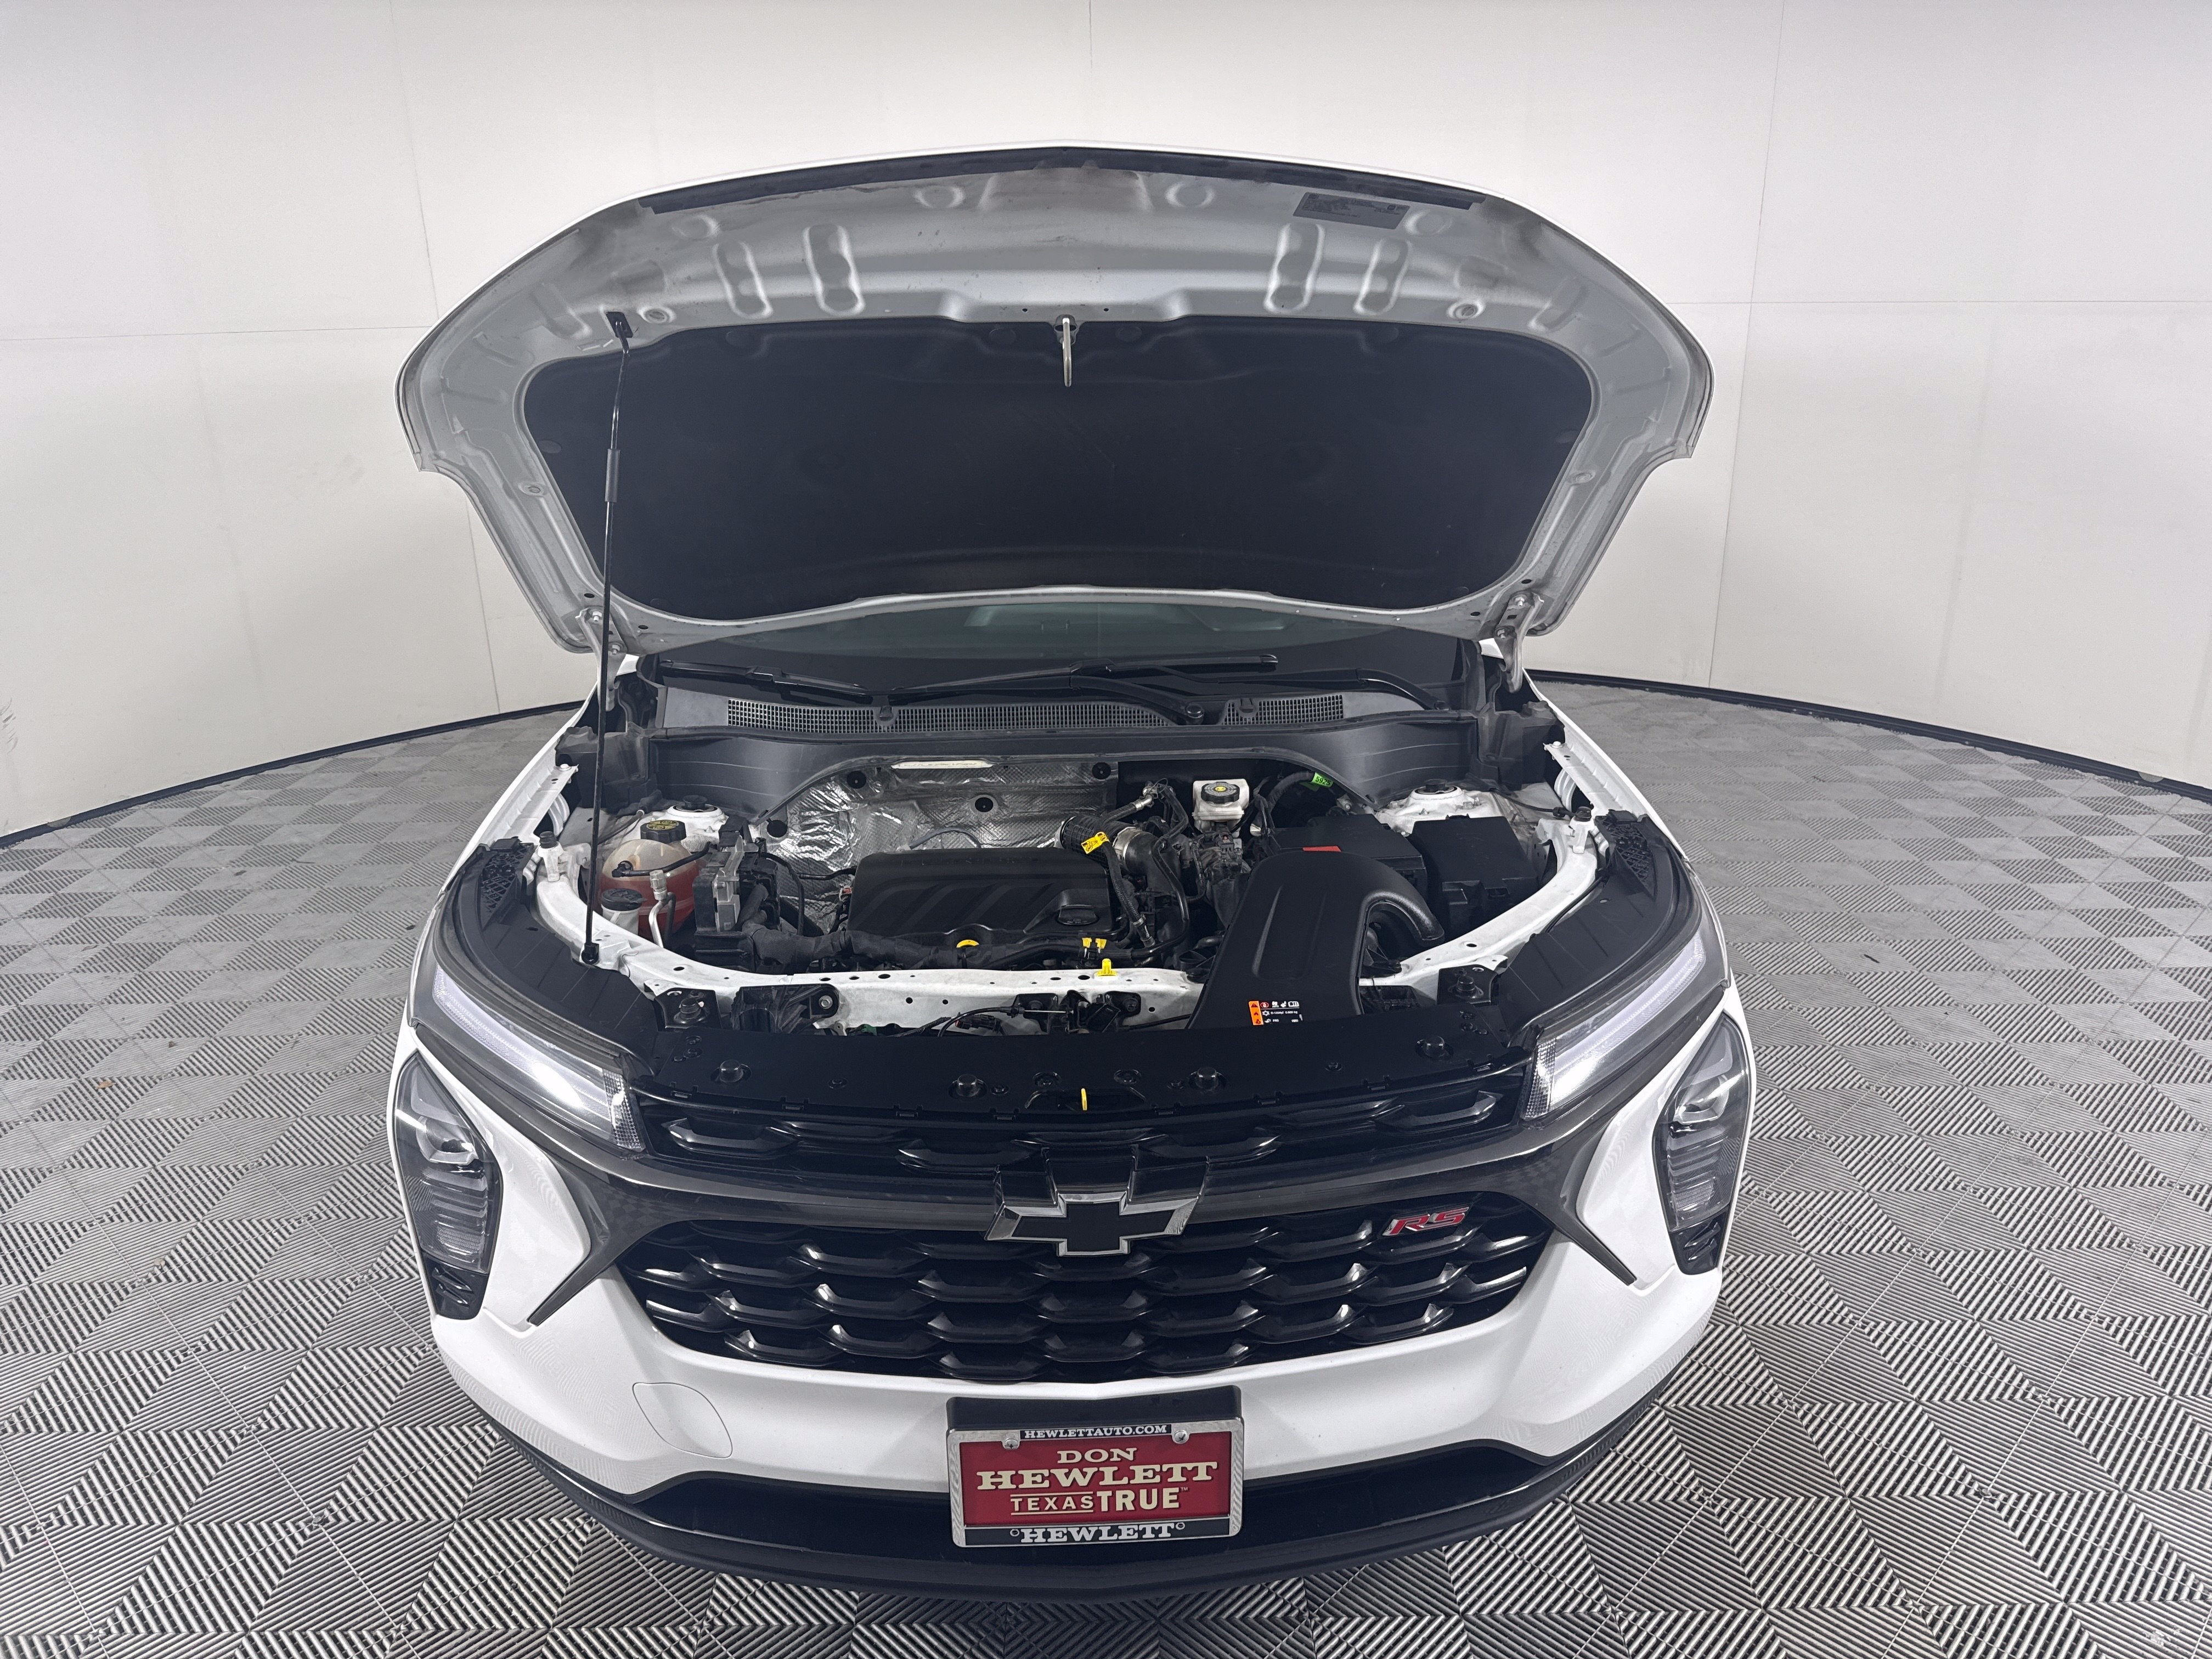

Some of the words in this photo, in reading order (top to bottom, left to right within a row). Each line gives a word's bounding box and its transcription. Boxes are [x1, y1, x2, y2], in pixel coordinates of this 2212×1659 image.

[1315, 776, 1331, 786] 5925
[1383, 1206, 1469, 1236] RS
[1024, 1425, 1167, 1438] HEWLETTAUTO.COM
[1057, 1448, 1137, 1464] DON
[977, 1462, 1218, 1491] HEWLETT
[1020, 1522, 1175, 1543] HEWLETT
